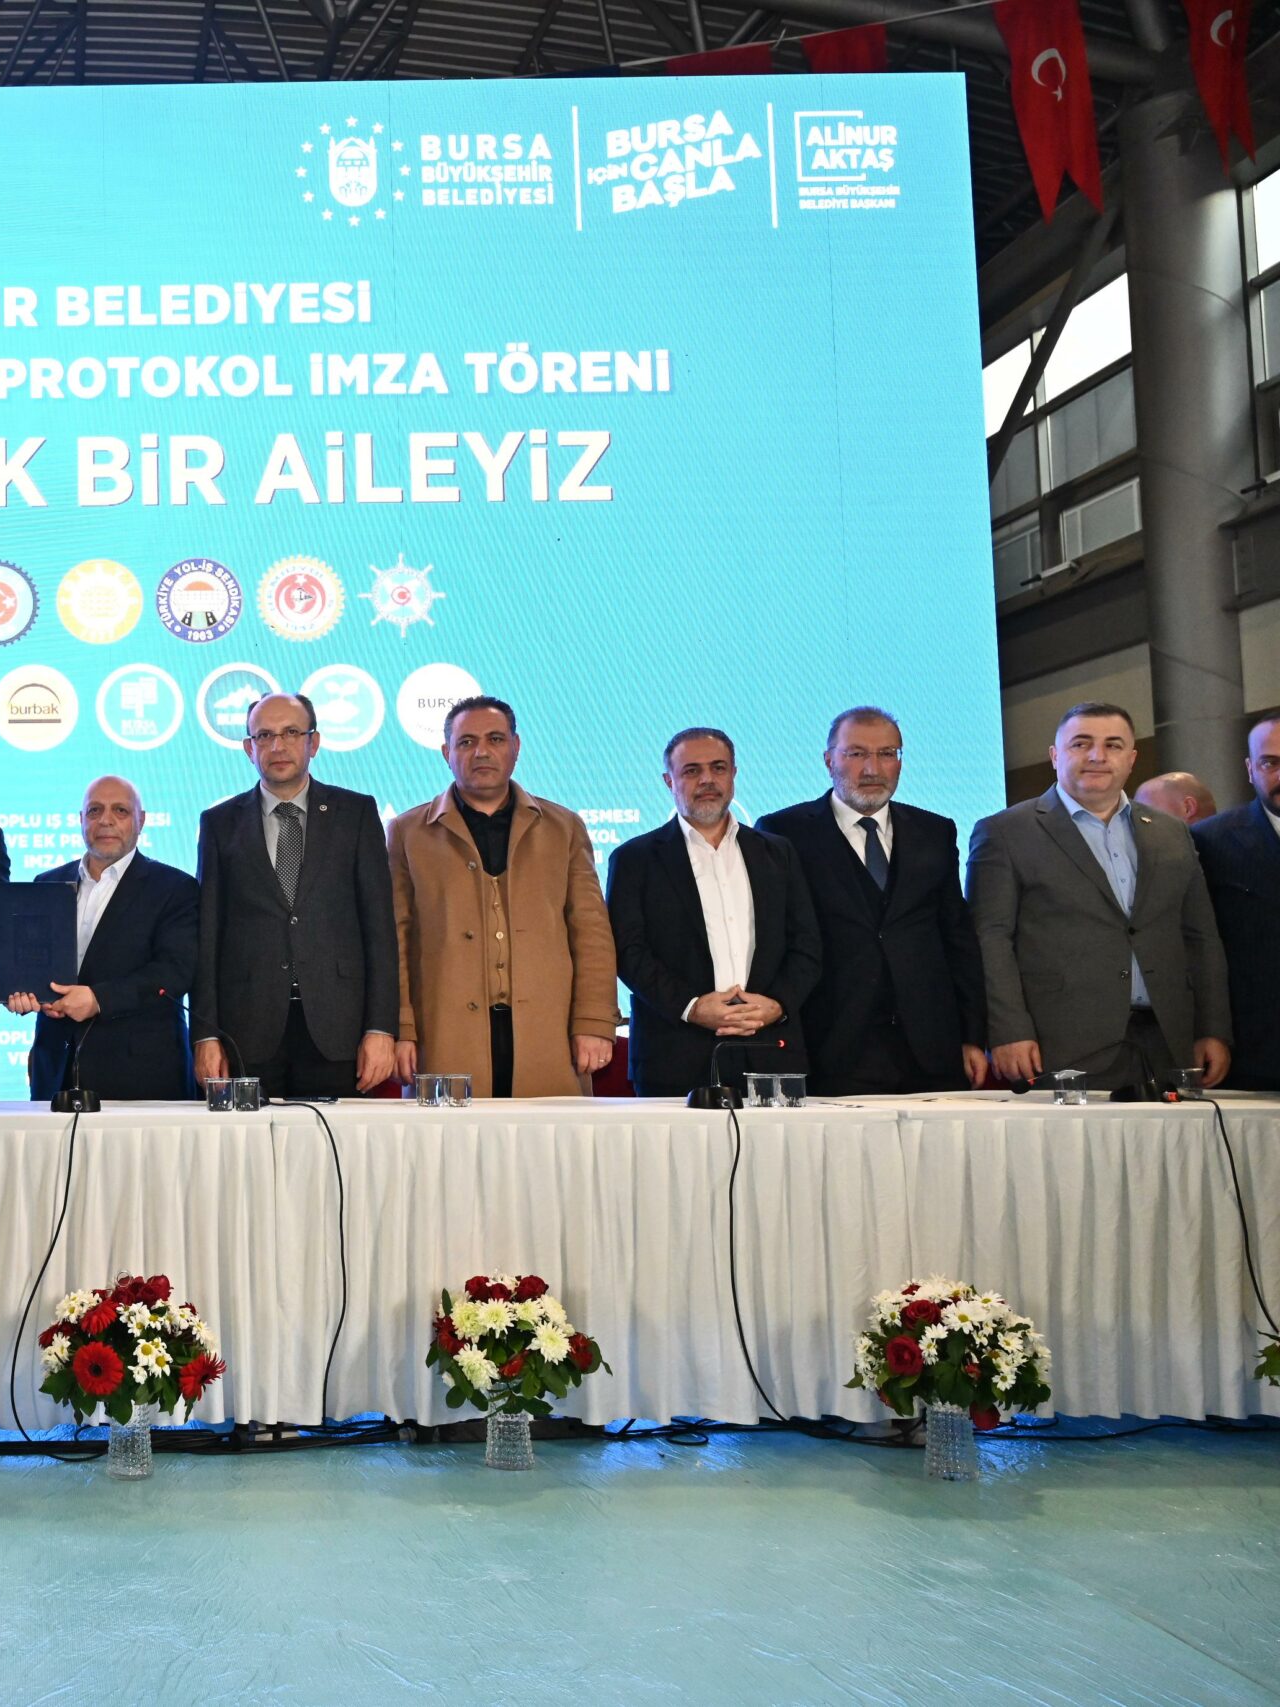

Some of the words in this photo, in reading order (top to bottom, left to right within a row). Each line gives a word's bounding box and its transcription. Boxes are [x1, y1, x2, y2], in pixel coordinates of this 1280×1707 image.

[420, 133, 553, 161] BURSA
[606, 110, 734, 158] BURSA
[629, 133, 763, 181] CANLA
[811, 148, 895, 172] AKTAŞ
[421, 160, 553, 185] BÜYÜKŞEHİR
[421, 183, 554, 206] BELEDİYESİ
[612, 166, 736, 214] BAŞLA
[214, 567, 242, 629] SENDİKASI
[10, 703, 59, 715] burbak
[7, 834, 28, 848] VE
[33, 834, 53, 848] EK
